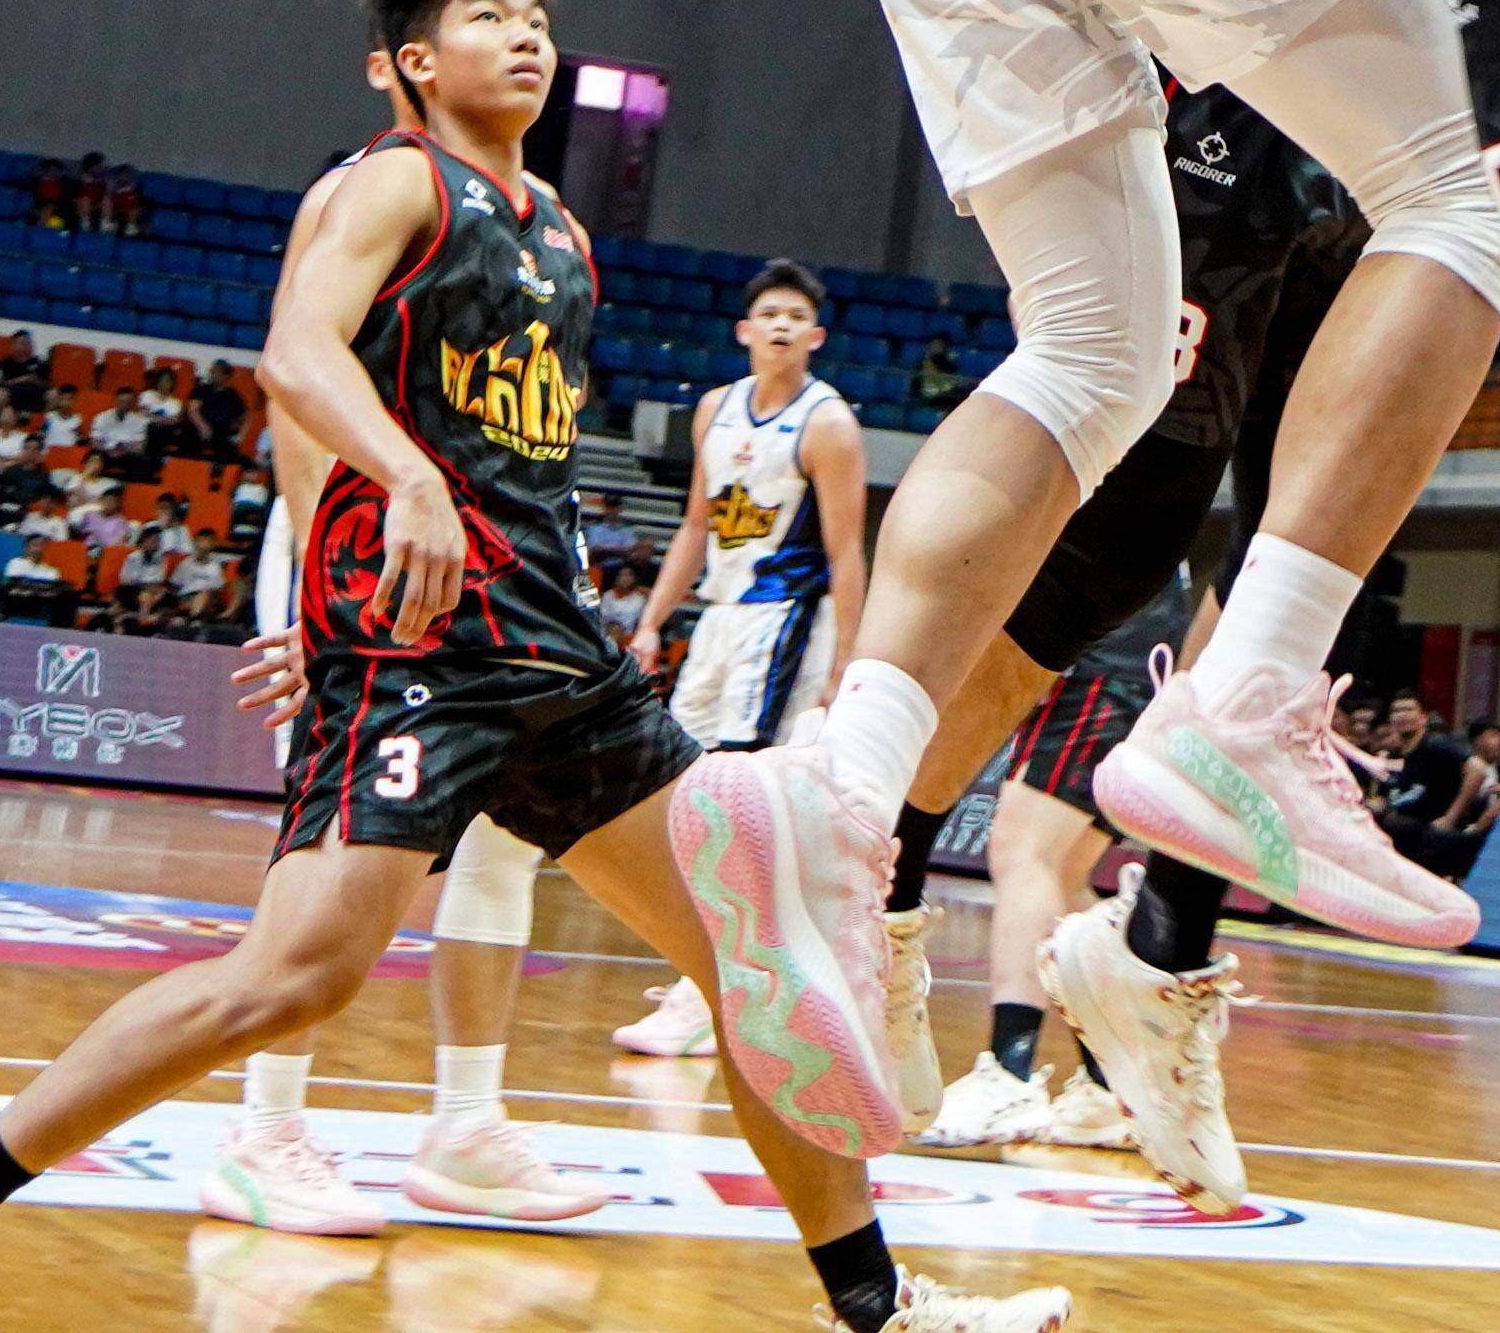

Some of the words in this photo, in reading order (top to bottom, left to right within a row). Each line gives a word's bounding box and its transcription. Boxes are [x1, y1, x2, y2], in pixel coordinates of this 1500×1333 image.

[1174, 156, 1237, 187] RIGORER
[481, 424, 571, 462] 2024
[373, 735, 424, 802] 3
